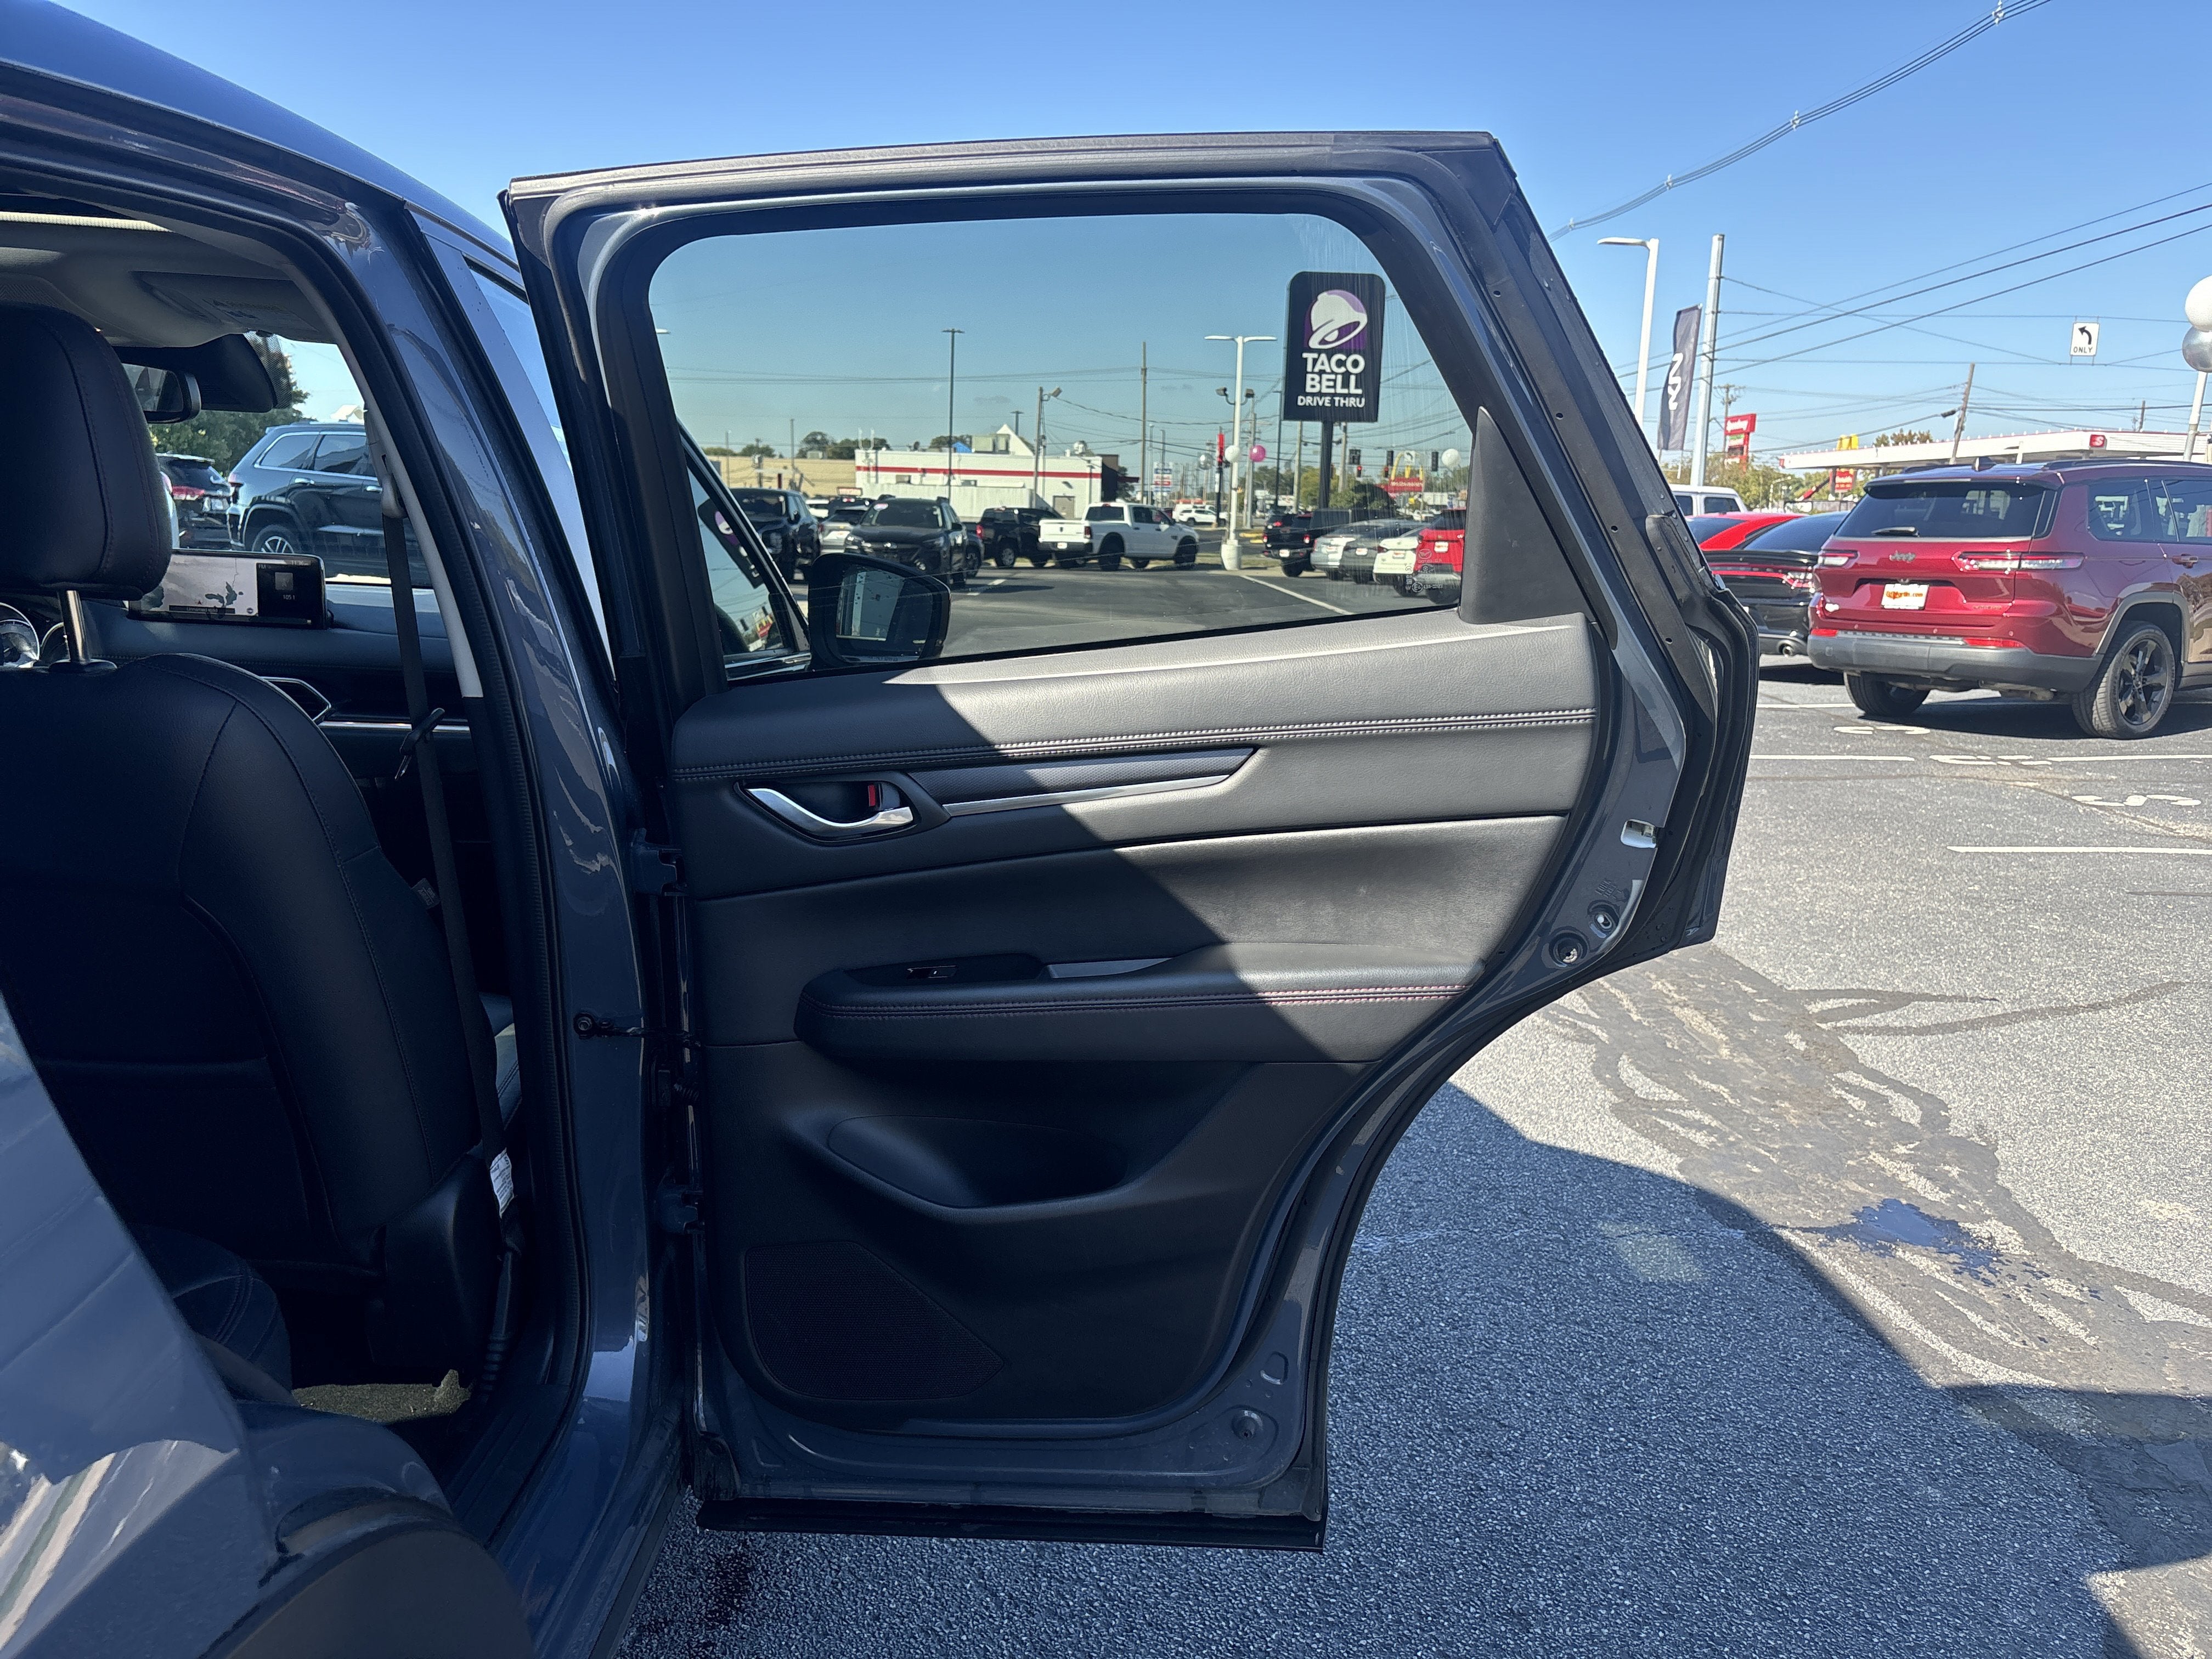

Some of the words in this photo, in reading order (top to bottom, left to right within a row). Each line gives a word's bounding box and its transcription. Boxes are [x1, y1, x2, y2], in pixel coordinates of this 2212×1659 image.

[1302, 352, 1365, 373] TACO
[1305, 373, 1362, 394] BELL
[1297, 396, 1331, 407] DRIVE
[1334, 397, 1365, 408] THRU
